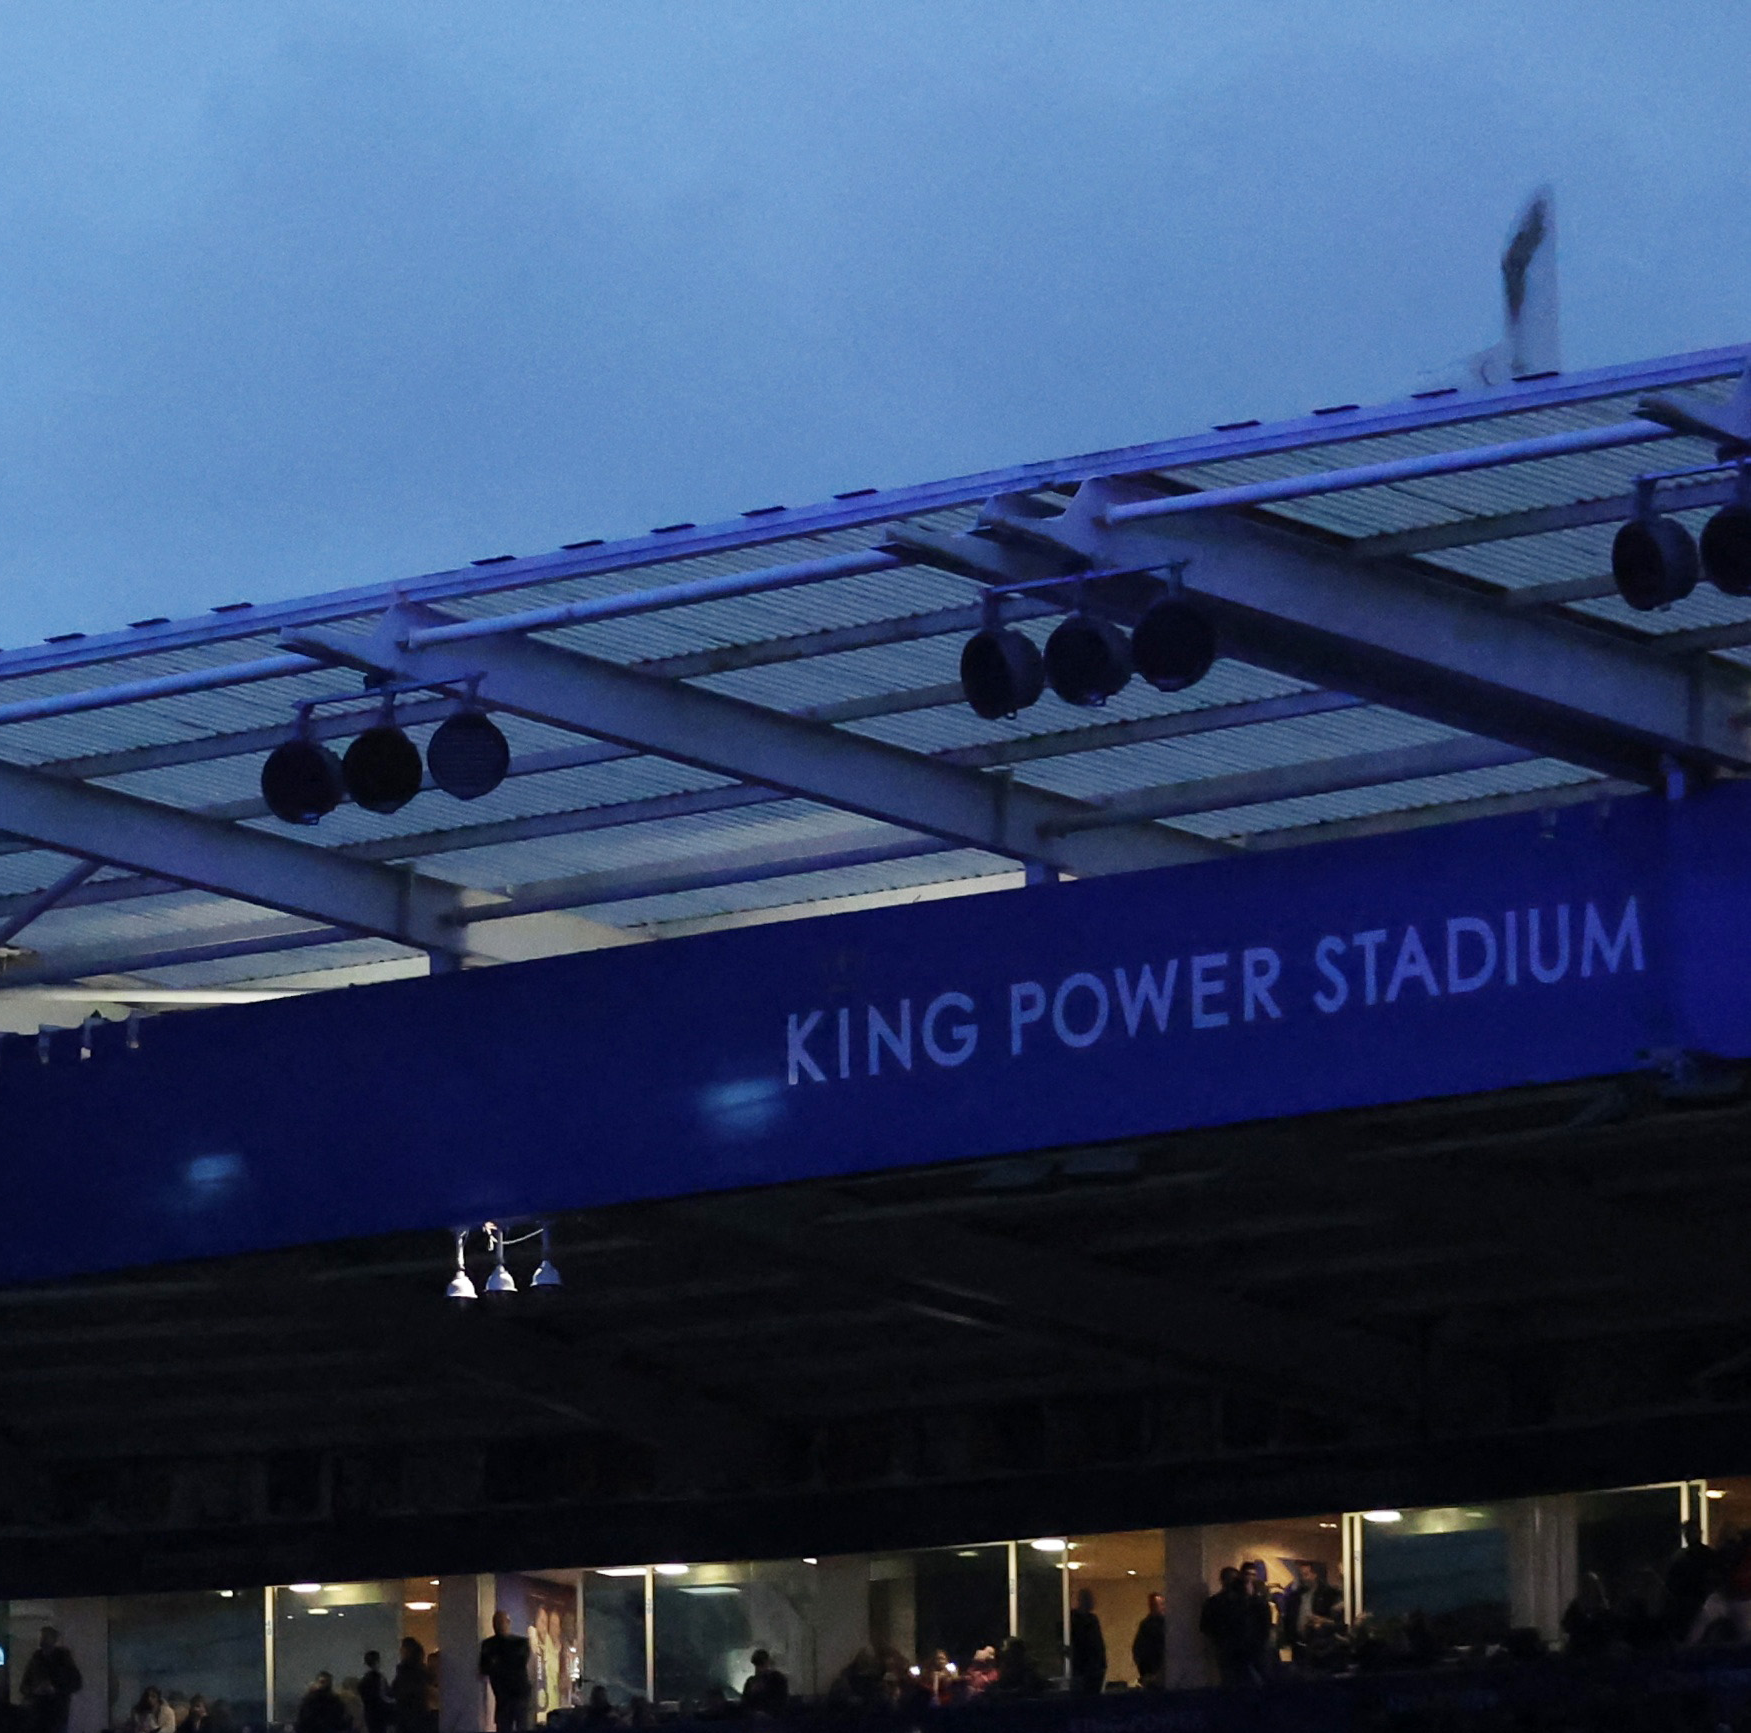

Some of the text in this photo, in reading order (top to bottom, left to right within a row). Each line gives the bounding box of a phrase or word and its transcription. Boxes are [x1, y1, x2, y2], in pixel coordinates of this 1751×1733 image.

[787, 895, 1644, 1085] KING POWER STADIUM
